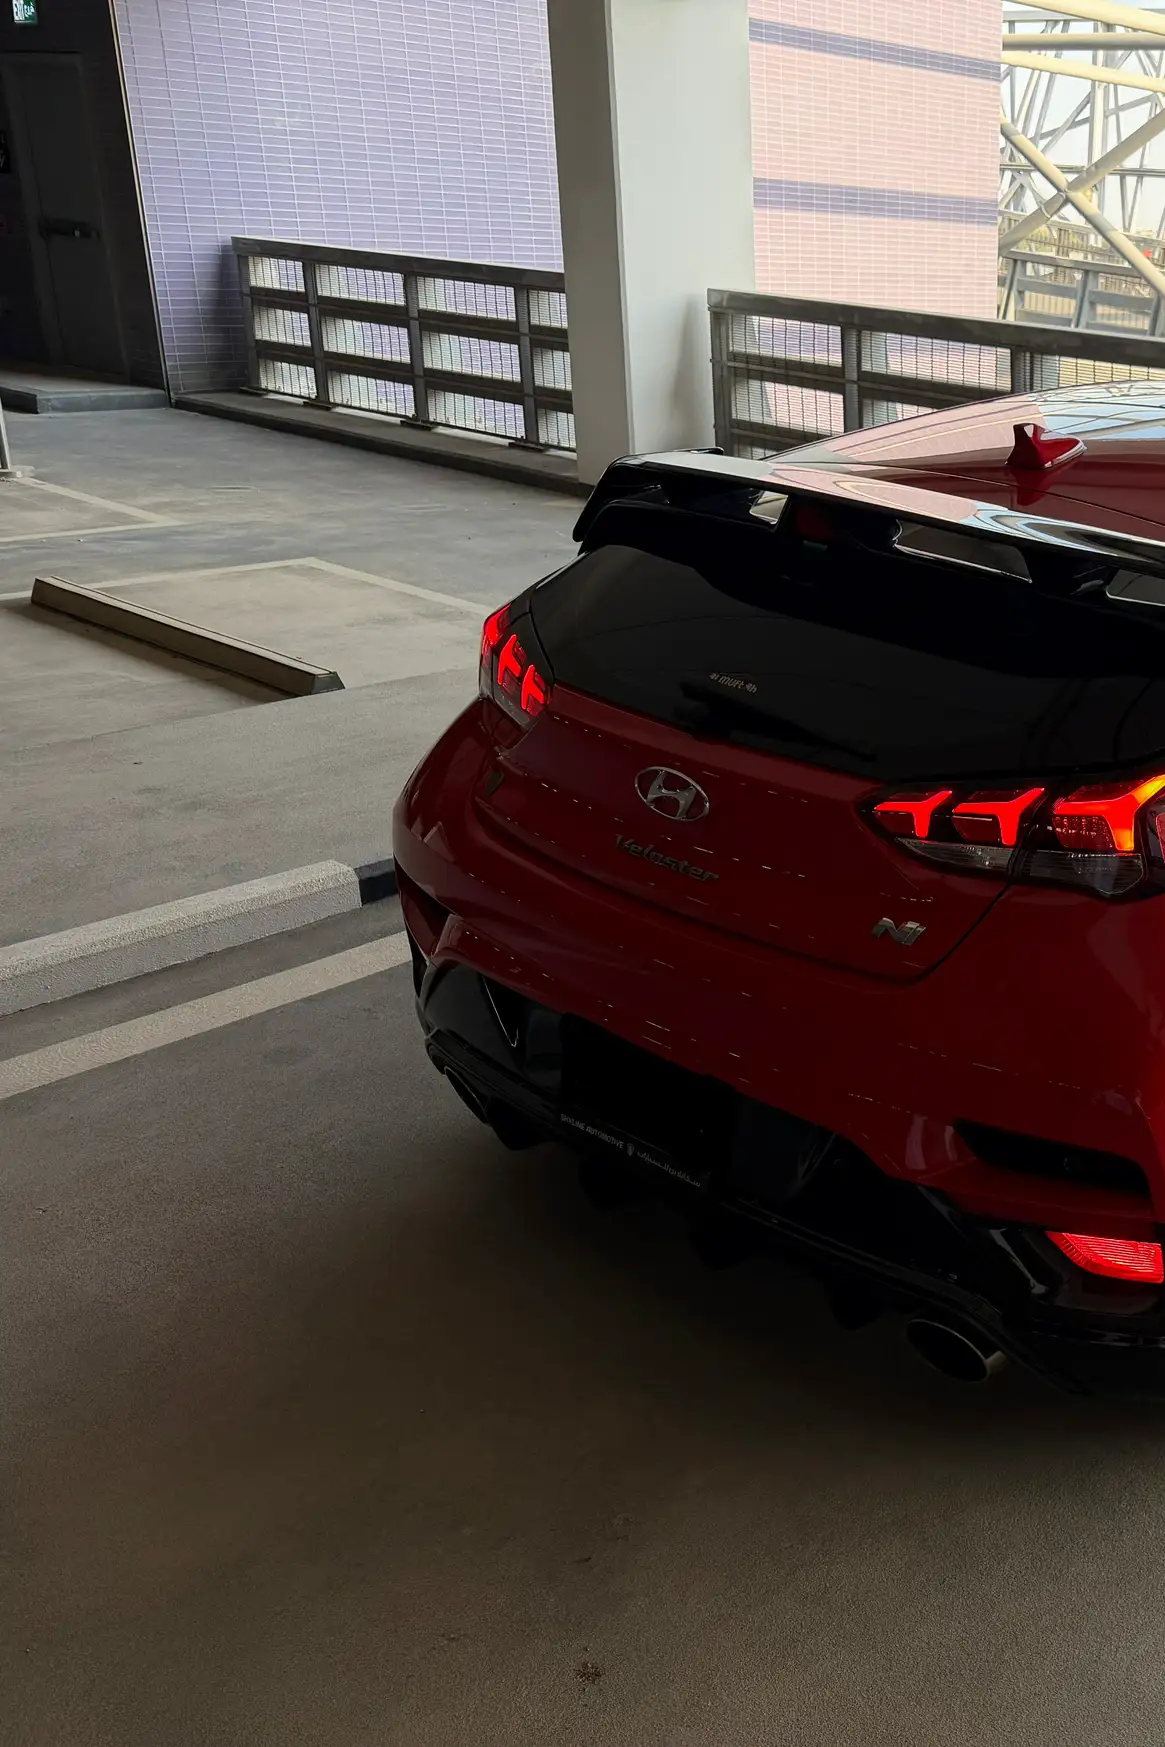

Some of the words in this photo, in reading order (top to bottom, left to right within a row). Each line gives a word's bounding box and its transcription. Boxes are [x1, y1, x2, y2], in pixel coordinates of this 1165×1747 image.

[615, 834, 720, 882] Veloster
[559, 1113, 586, 1131] SKYLINE
[586, 1125, 625, 1149] AUTOMOTIVE
